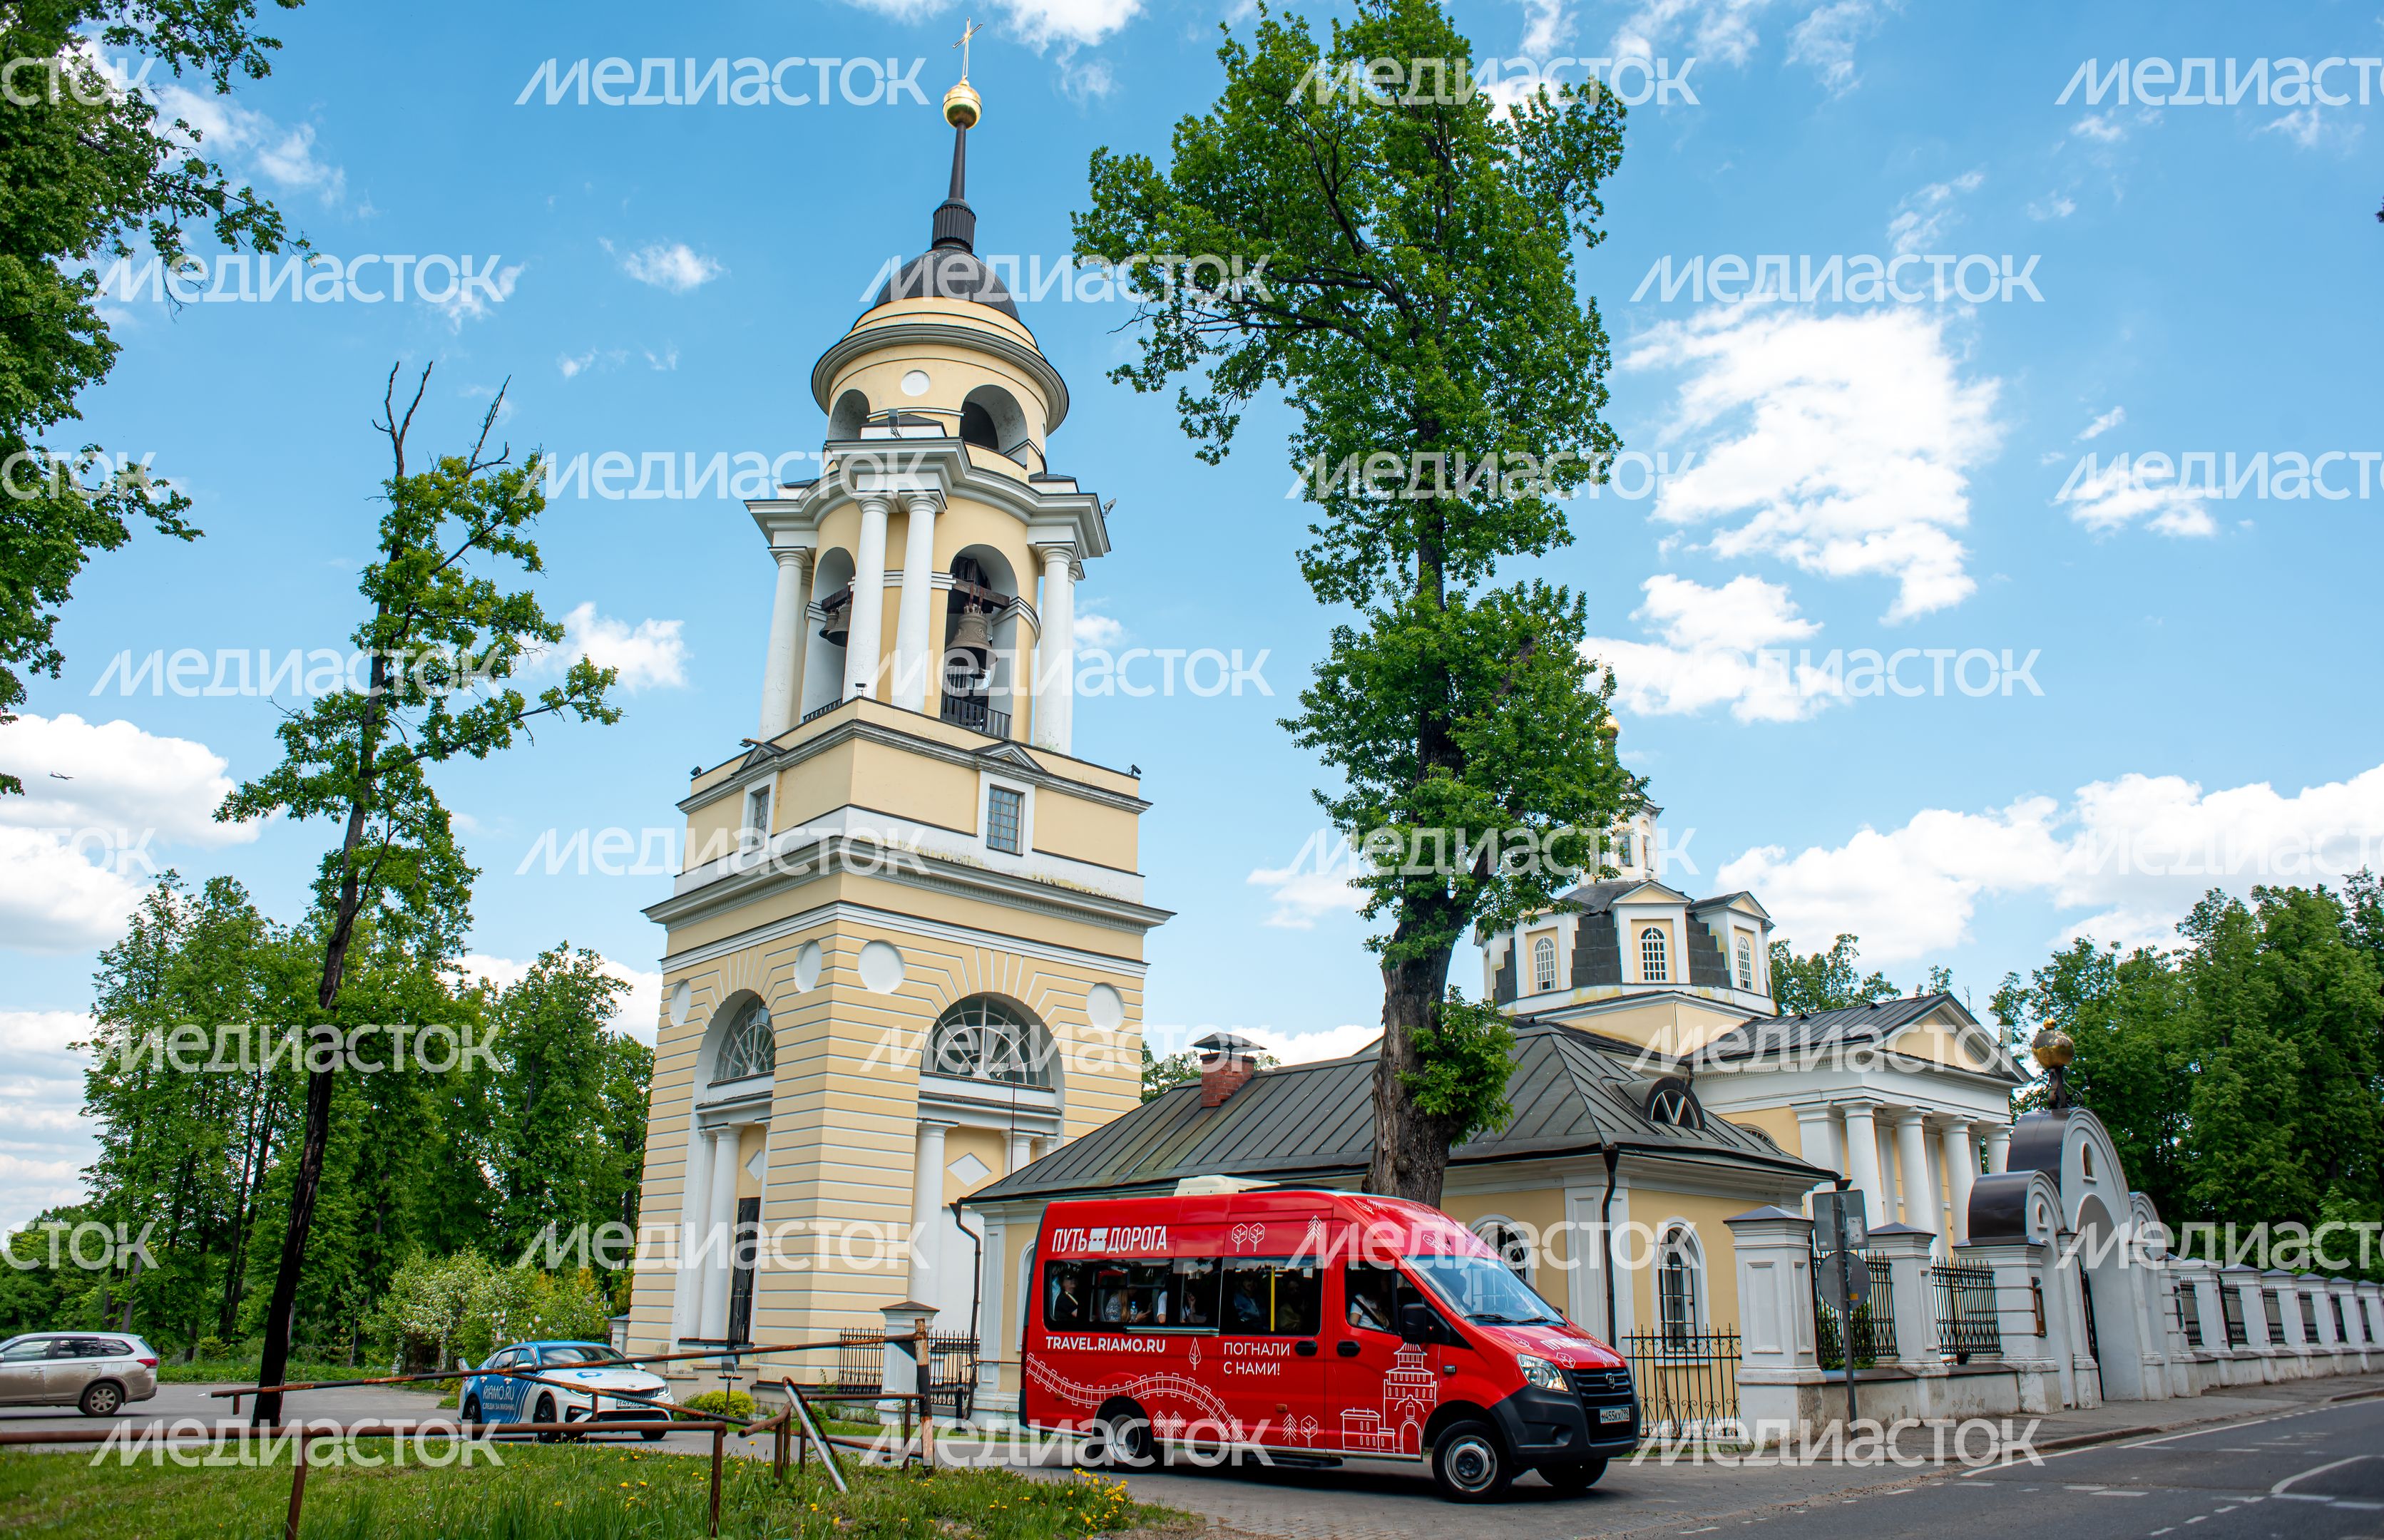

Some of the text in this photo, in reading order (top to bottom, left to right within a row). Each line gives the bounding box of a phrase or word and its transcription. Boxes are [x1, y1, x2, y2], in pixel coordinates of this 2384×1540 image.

[1052, 1226, 1167, 1253] ПУТЬ ДОРОГА
[1046, 1336, 1166, 1352] TRAVEL.RIAMO.RU
[1224, 1342, 1290, 1356] ПОГНАЛИ
[1224, 1361, 1280, 1376] С НАМИ!
